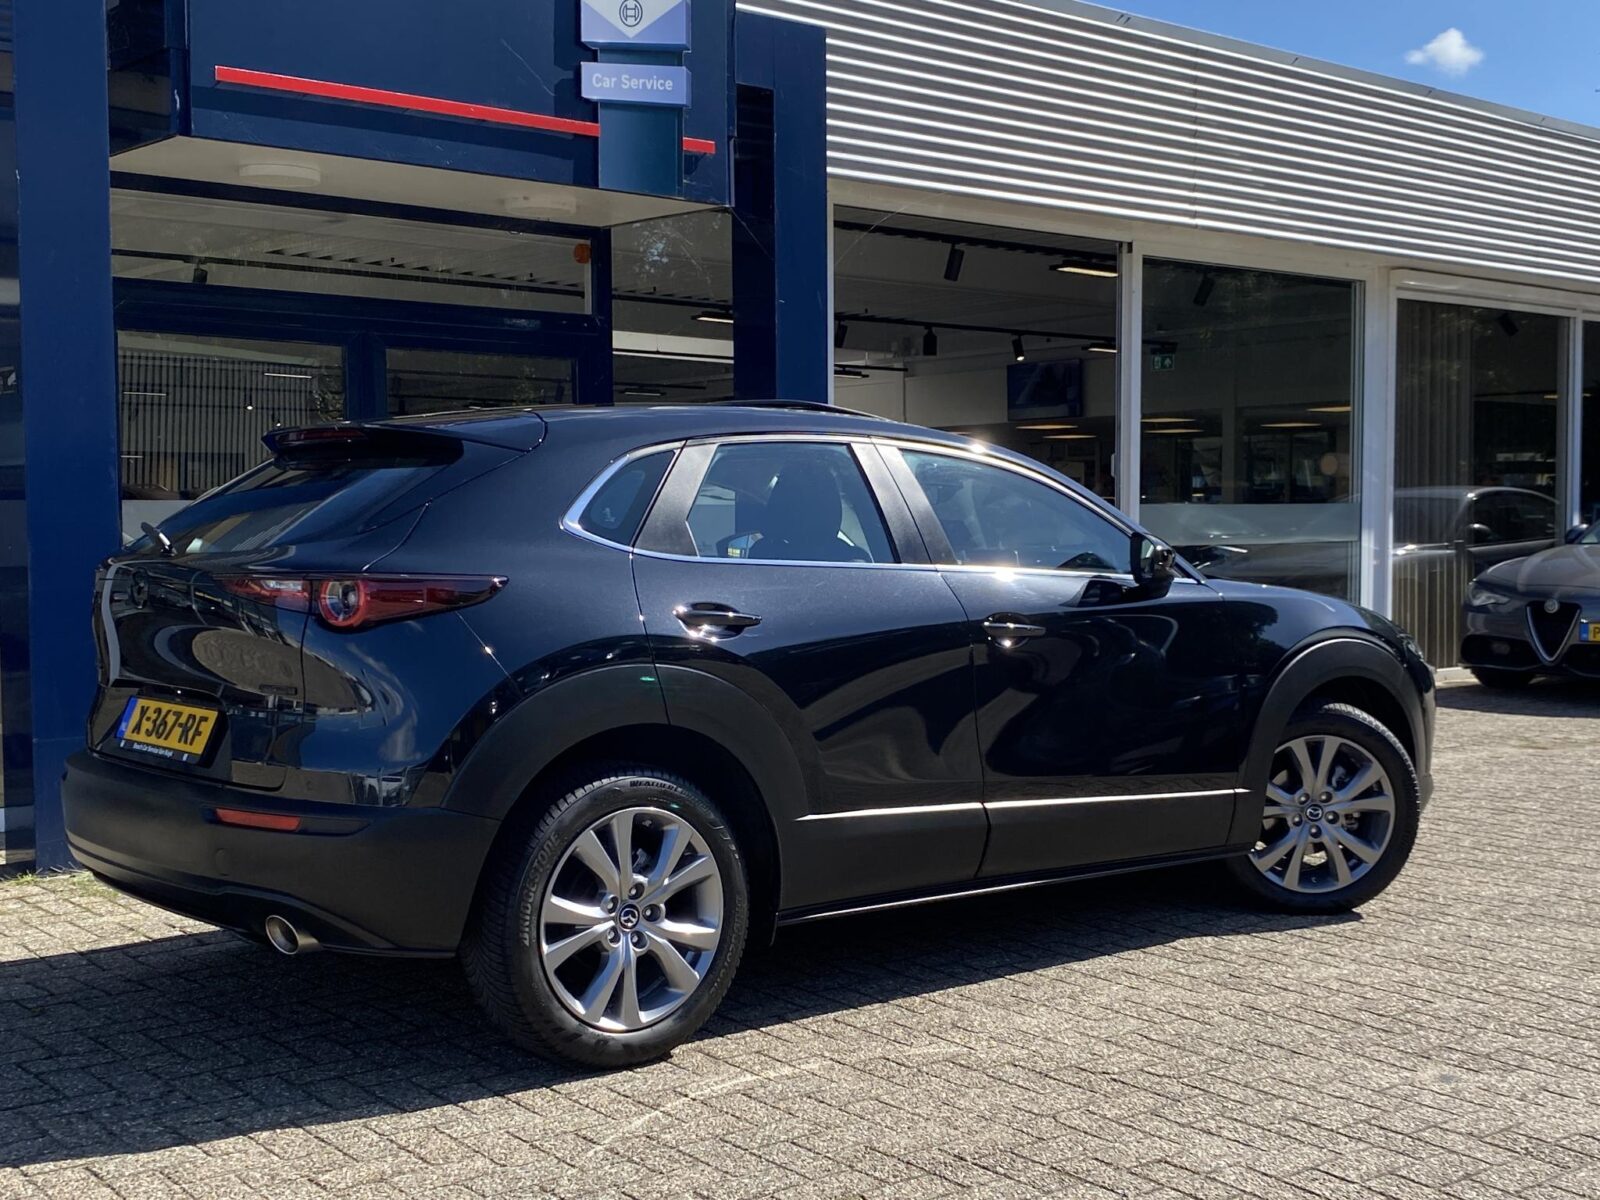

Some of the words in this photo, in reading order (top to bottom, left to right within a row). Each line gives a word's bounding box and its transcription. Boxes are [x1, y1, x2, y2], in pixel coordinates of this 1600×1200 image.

[592, 73, 617, 89] Car
[621, 74, 673, 91] Service
[131, 705, 209, 746] X-367-RF
